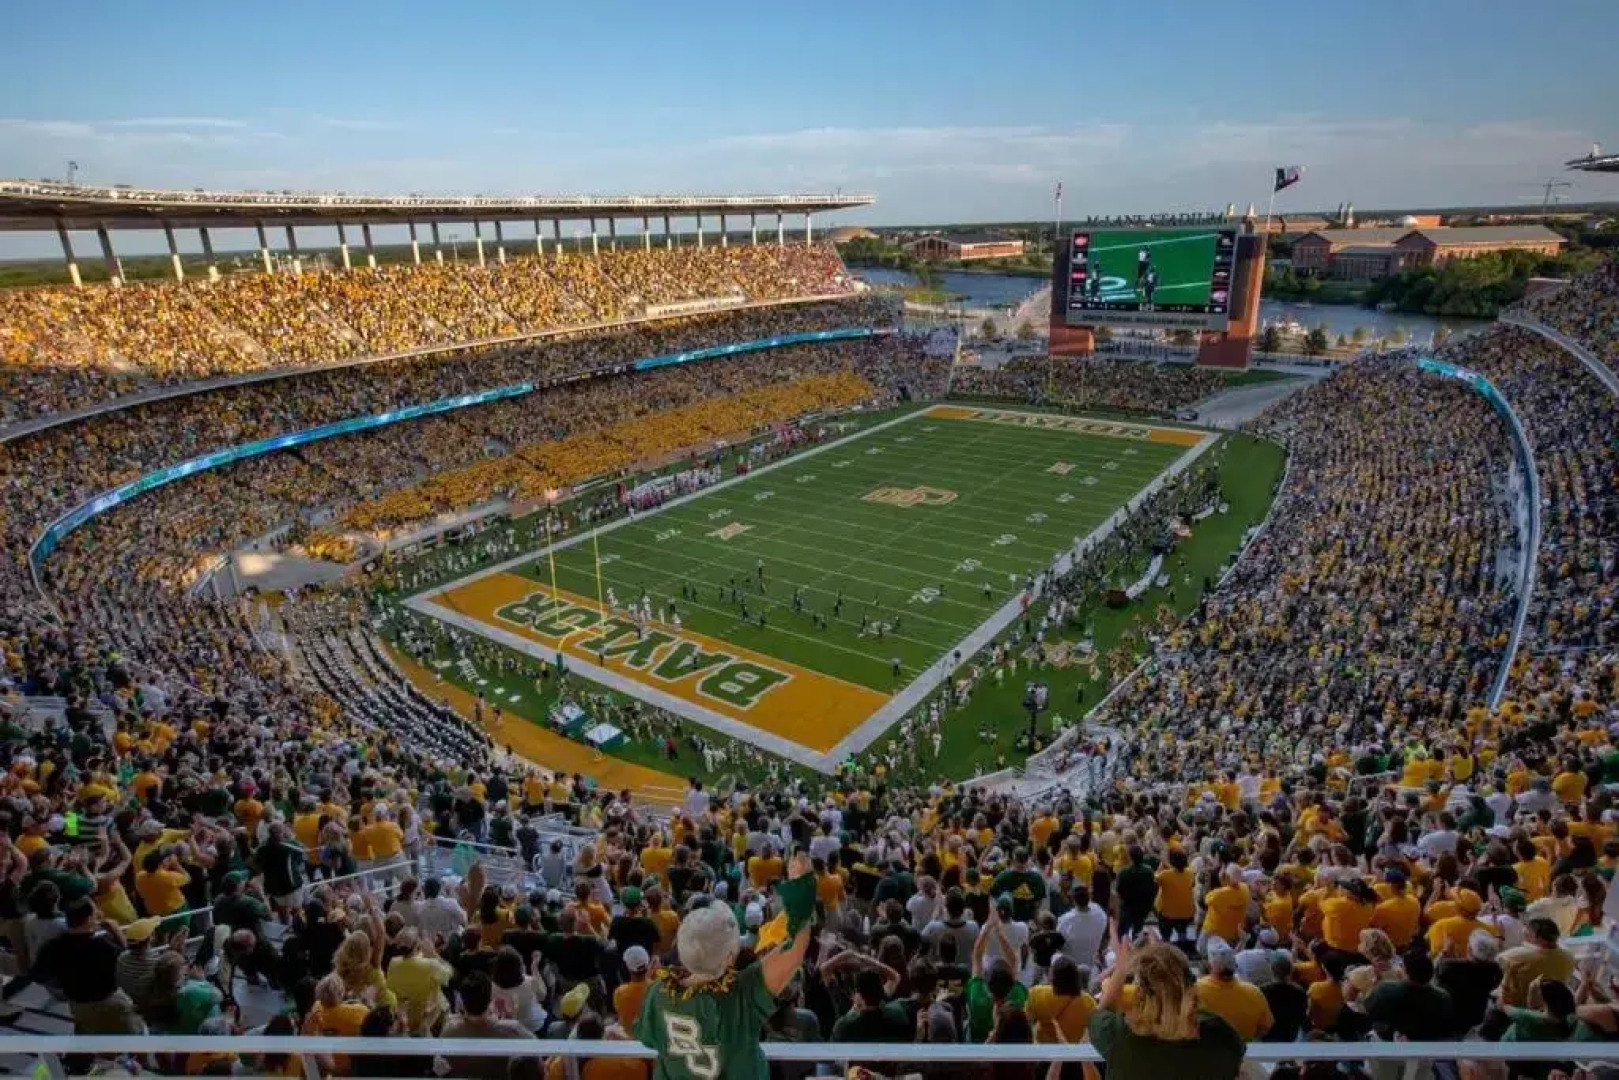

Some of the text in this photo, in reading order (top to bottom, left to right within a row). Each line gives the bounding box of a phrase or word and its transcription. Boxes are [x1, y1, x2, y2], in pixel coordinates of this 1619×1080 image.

[1151, 211, 1226, 226] STADIUM
[493, 591, 794, 710] BAYLOR
[665, 1012, 721, 1077] BU
